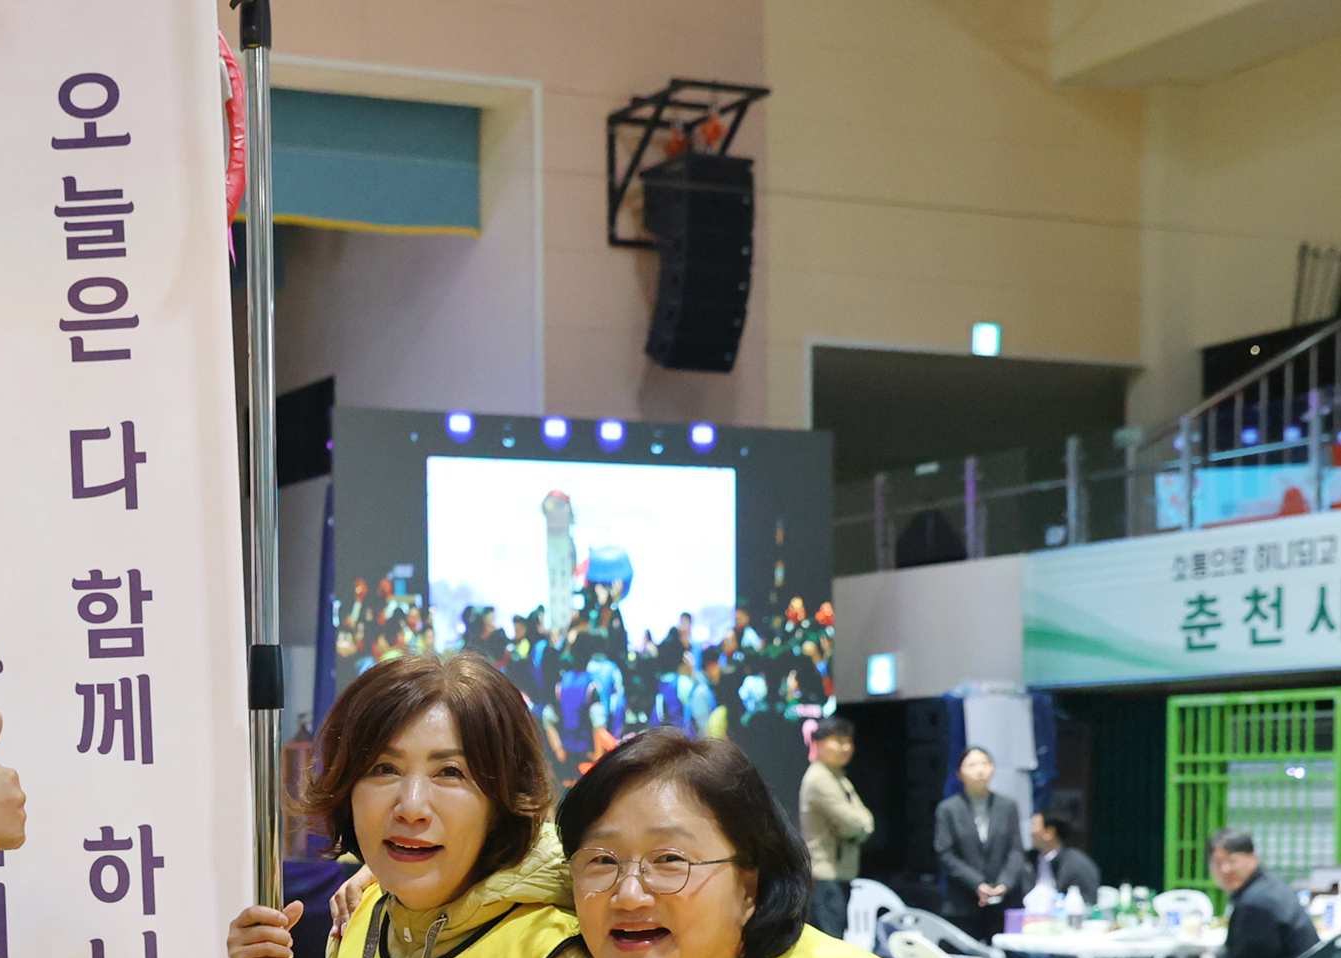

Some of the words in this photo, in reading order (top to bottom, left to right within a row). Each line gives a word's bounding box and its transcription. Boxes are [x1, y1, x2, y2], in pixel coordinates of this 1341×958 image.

[51, 72, 140, 362] 오늘은
[68, 420, 147, 511] 다
[71, 568, 154, 765] 함께
